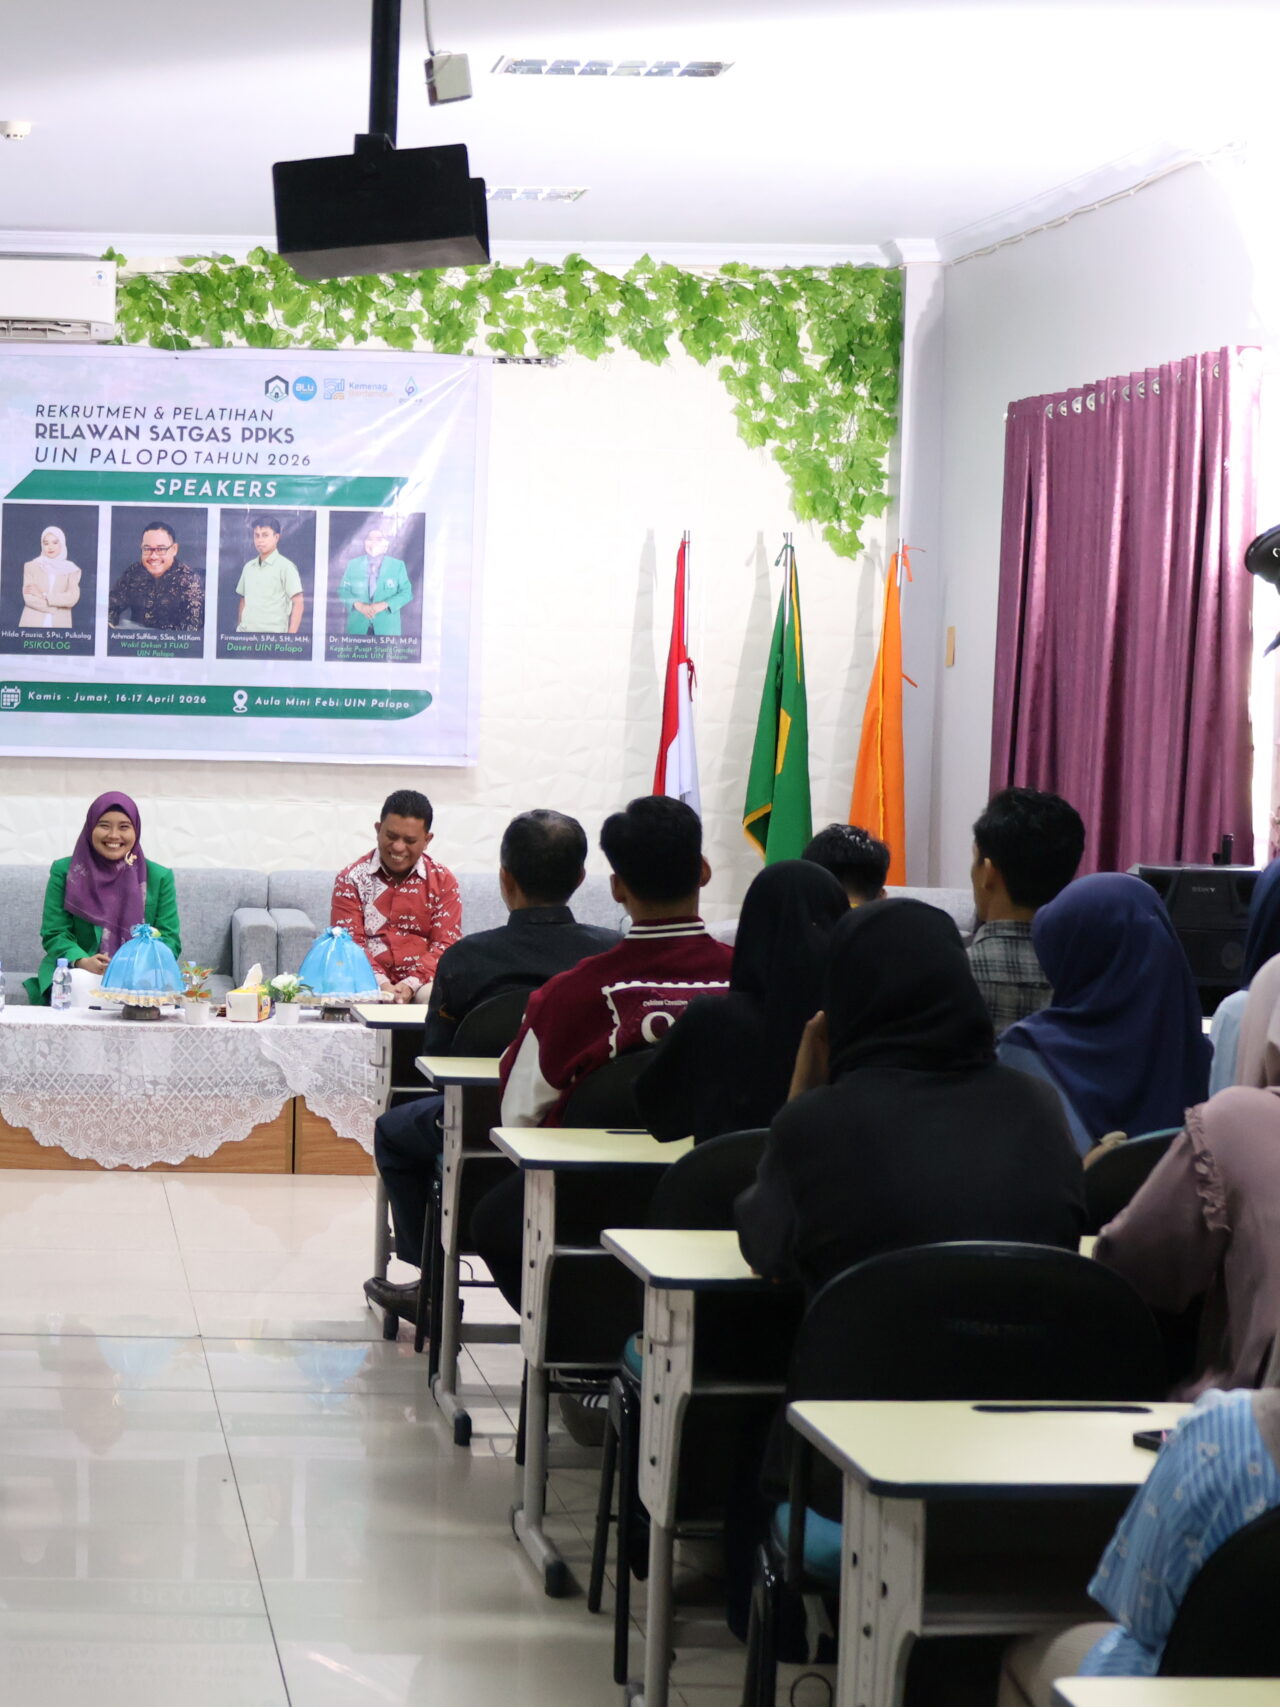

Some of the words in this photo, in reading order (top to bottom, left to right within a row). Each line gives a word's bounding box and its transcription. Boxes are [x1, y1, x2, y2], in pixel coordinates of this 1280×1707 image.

[35, 404, 146, 420] REKRUTMEN
[154, 406, 164, 420] &
[172, 407, 274, 422] PELATIHAN
[35, 423, 140, 441] RELAWAN
[149, 425, 232, 442] SATGAS
[241, 427, 295, 444] PPKS
[34, 447, 77, 464] UIN
[89, 448, 188, 465] PALOPO
[195, 451, 259, 466] TAHUN
[267, 453, 311, 467] 2026
[154, 478, 277, 498] SPEAKERS
[23, 640, 71, 650] PSIKOLOG
[255, 643, 272, 652] UIN
[28, 691, 62, 703] Kamis
[73, 692, 111, 704] Jumat,
[115, 693, 143, 704] 16-17
[146, 693, 175, 706] April
[179, 695, 207, 705] 2026
[255, 696, 280, 706] Aula
[285, 697, 310, 706] Mini
[314, 697, 339, 707] Febi
[344, 698, 366, 708] UIN
[370, 698, 410, 710] Palopo
